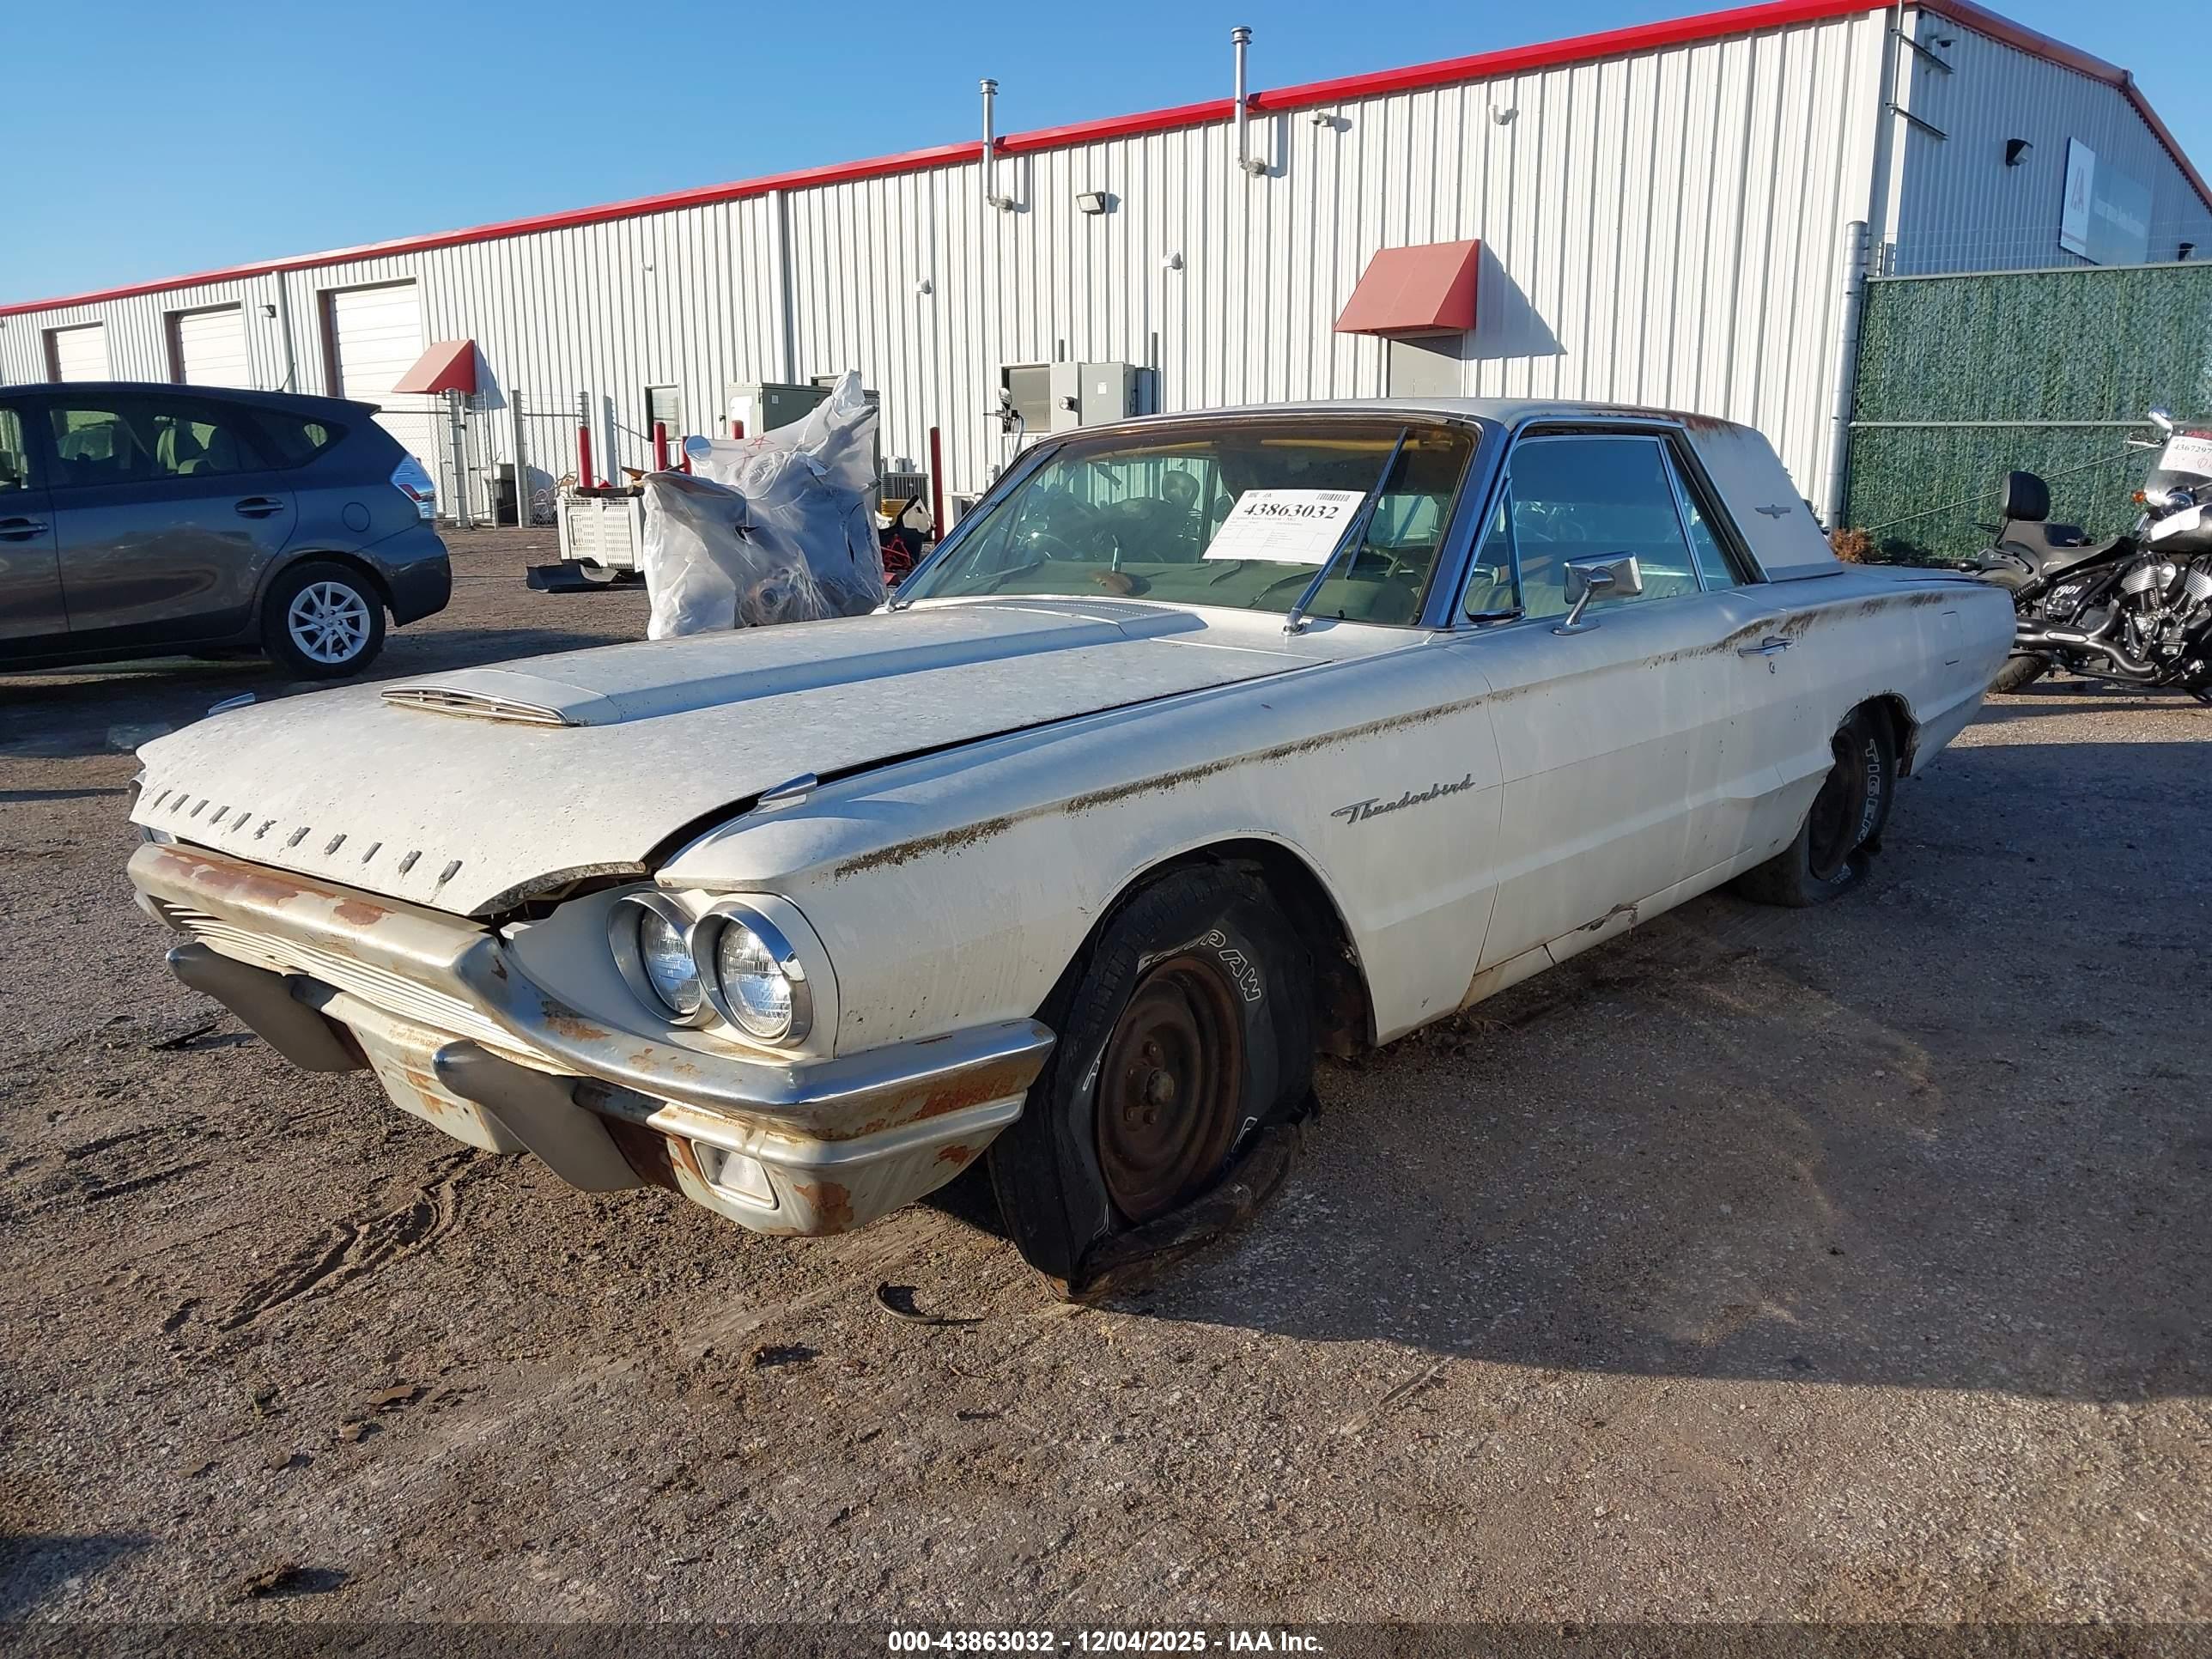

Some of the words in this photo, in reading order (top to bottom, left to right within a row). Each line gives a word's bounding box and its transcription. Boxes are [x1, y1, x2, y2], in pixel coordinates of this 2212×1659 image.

[1243, 502, 1340, 520] 43863032
[2051, 585, 2082, 599] 1901
[1330, 773, 1476, 825] Thunderbird
[1200, 929, 1261, 1002] PAW
